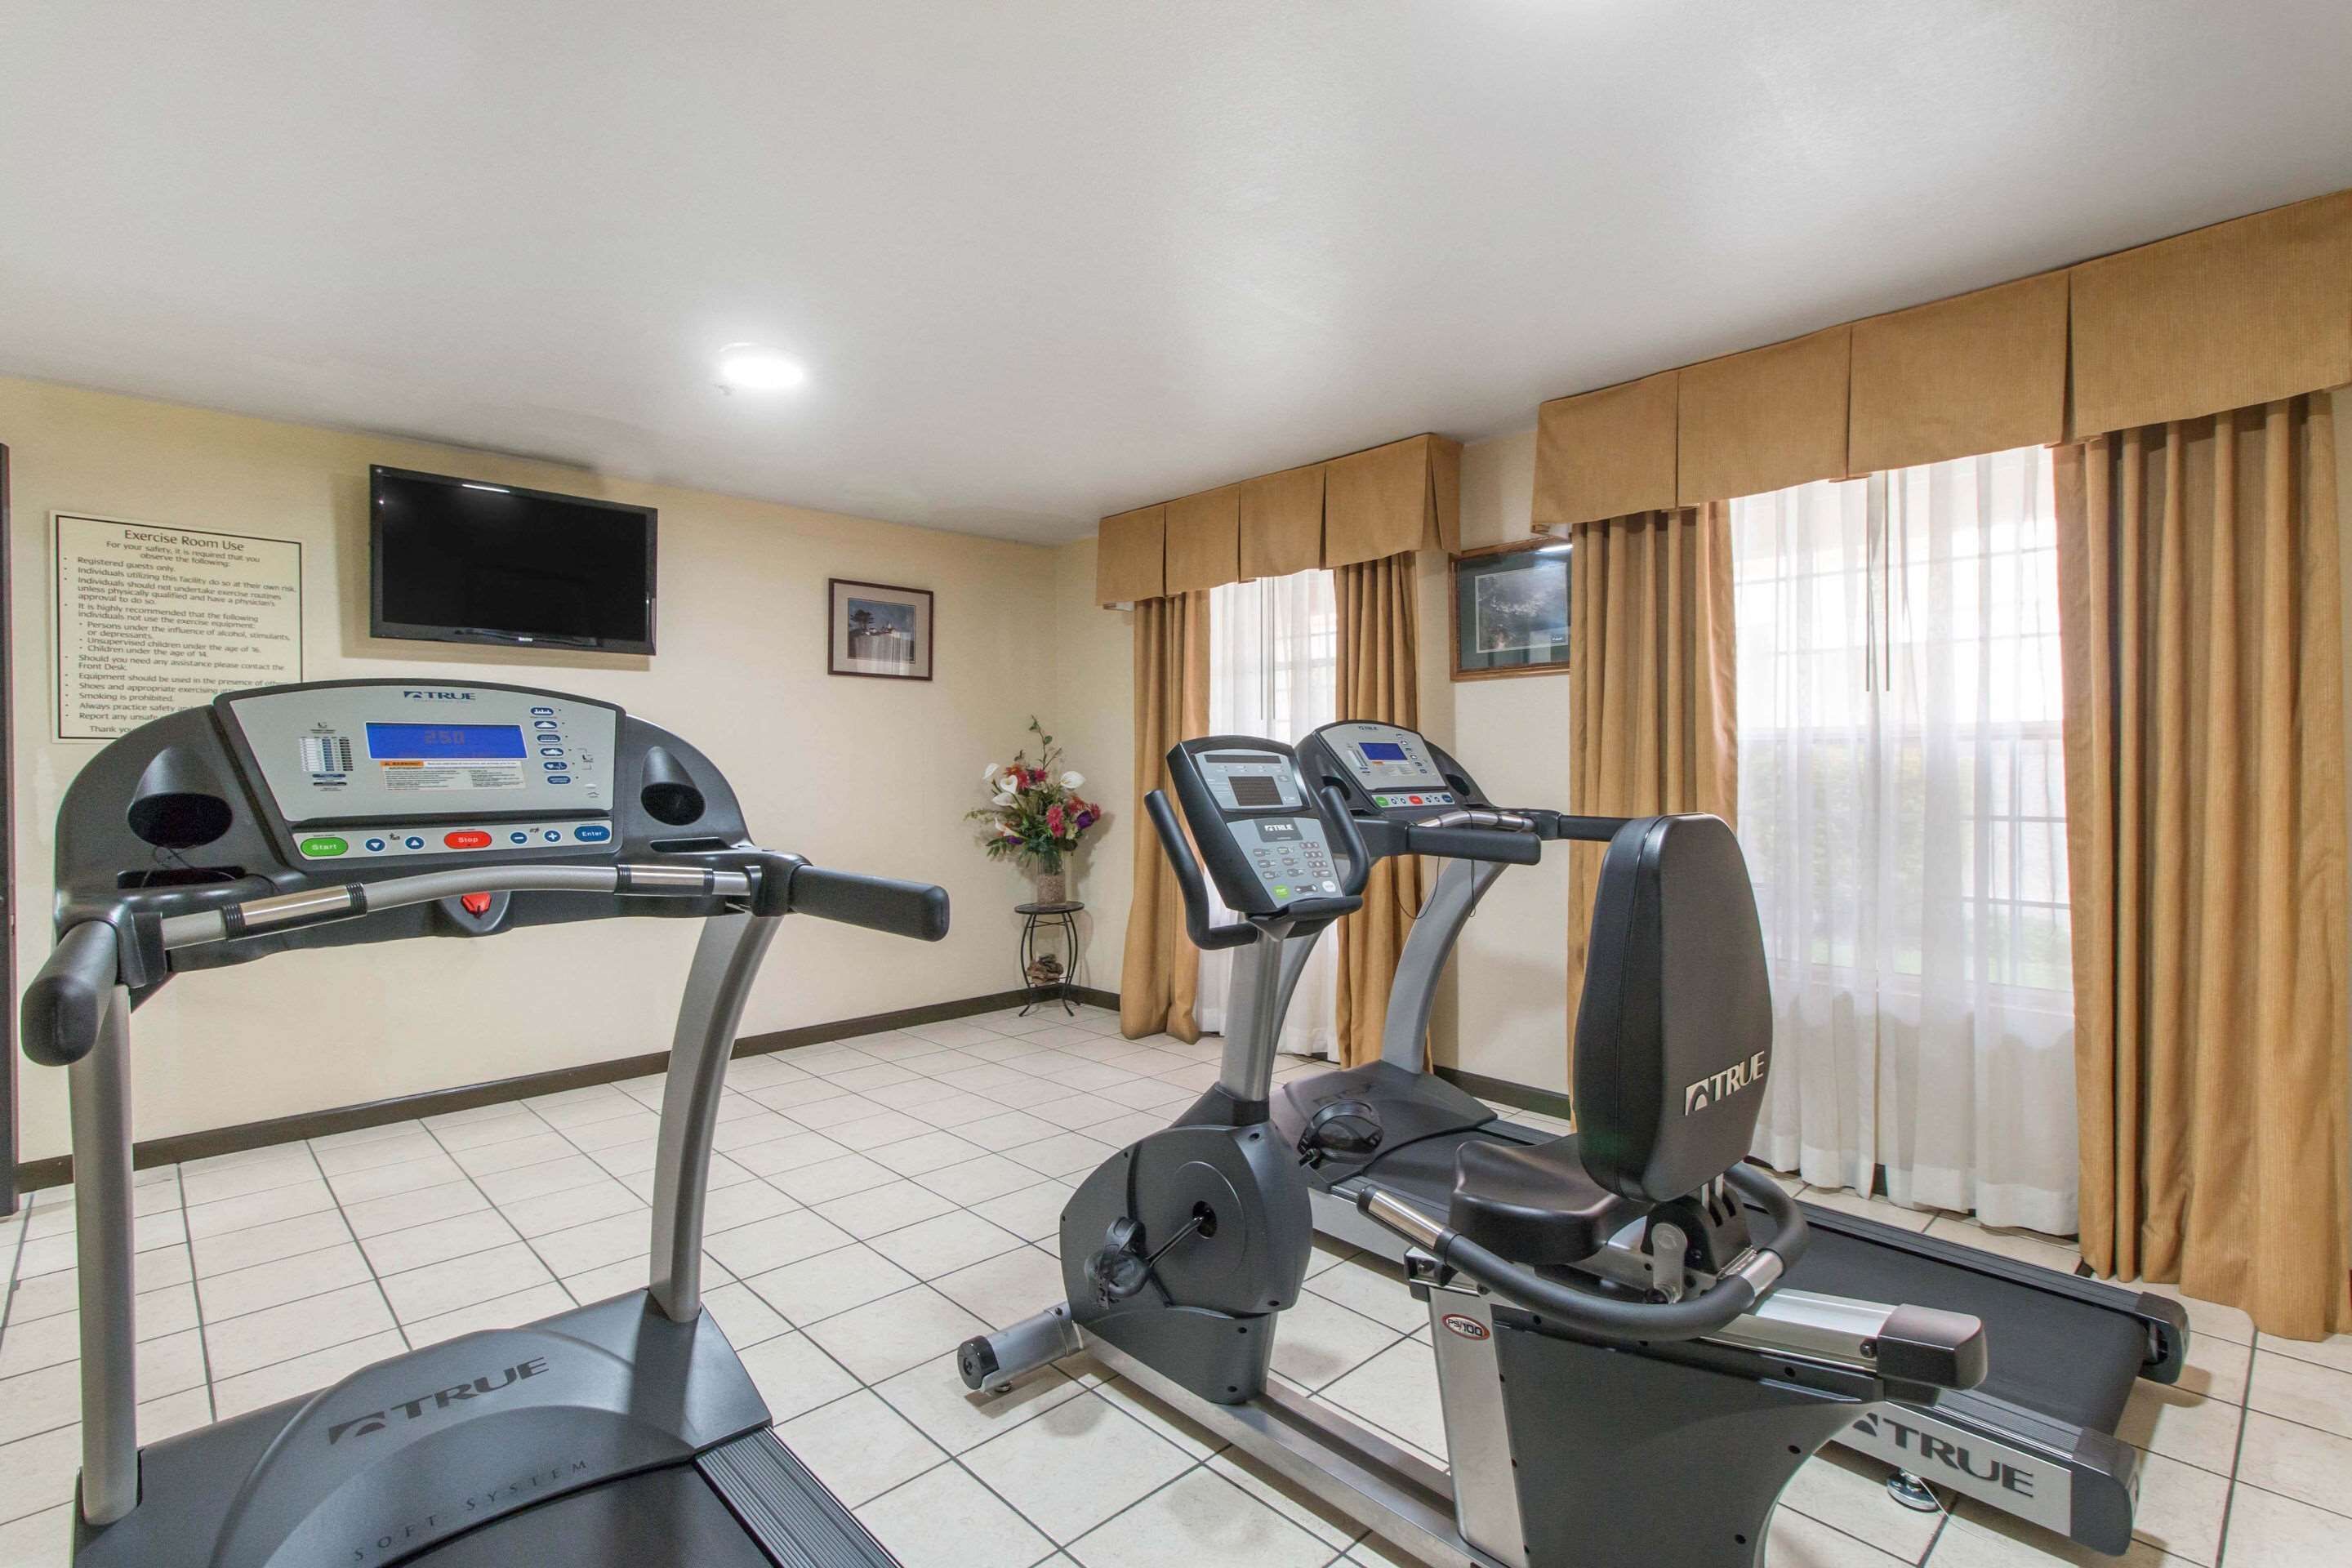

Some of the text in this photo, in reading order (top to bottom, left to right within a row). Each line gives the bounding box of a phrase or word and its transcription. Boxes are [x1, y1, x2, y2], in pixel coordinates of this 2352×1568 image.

[124, 529, 244, 550] Exercise Room Use
[140, 553, 174, 561] observe
[192, 550, 225, 559] required
[78, 556, 123, 568] Registered
[126, 562, 154, 570] guests
[78, 567, 124, 577] Individuals
[127, 571, 160, 581] utilizing
[180, 576, 207, 585] facility
[78, 577, 124, 586] Individuals
[173, 586, 216, 595] undertake
[251, 592, 282, 600] routines
[78, 585, 105, 593] unless
[108, 587, 149, 597] physically
[151, 590, 187, 599] qualified
[78, 594, 117, 602] approval
[96, 604, 122, 612] highly
[125, 606, 186, 617] recommended
[223, 613, 258, 622] following
[87, 621, 122, 630] Persons
[123, 623, 148, 631] under
[167, 626, 204, 635] influence
[87, 637, 145, 646] Unsupervised
[87, 644, 123, 653] Children
[78, 654, 109, 662] Should
[78, 672, 126, 680] Equipment
[78, 682, 105, 690] Shoes
[79, 693, 118, 701] Smoking
[423, 691, 476, 700] TRUE
[80, 702, 110, 710] Always
[79, 712, 109, 720] Report
[581, 830, 603, 838] Enter
[457, 836, 479, 844] Stop
[311, 842, 338, 851] Start
[1709, 1050, 1765, 1102] TRUE
[390, 1356, 550, 1419] TRUE
[1882, 1417, 2034, 1499] TRUE
[353, 1459, 587, 1561] SOFT SYSTEM
